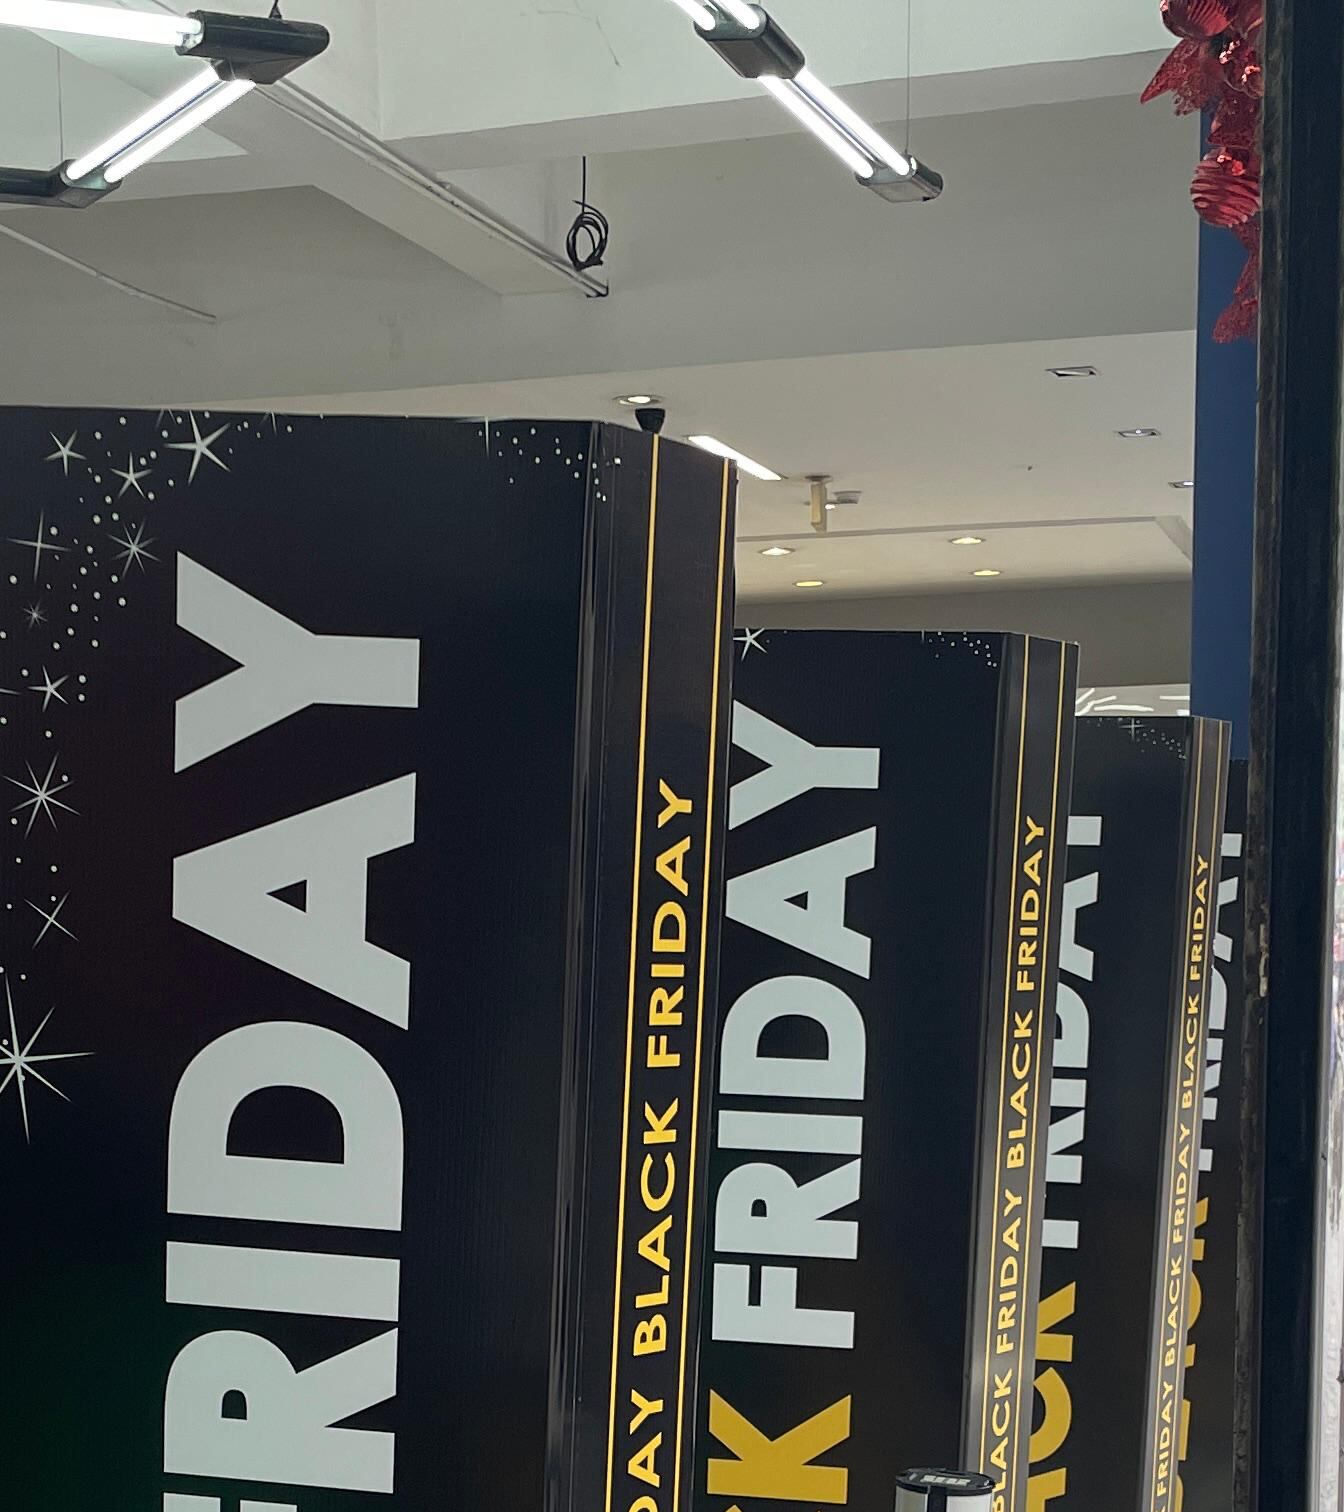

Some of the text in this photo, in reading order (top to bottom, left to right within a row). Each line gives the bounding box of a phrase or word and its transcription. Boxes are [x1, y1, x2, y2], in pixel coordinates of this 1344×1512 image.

[645, 777, 694, 1068] FRIDAY
[1014, 817, 1046, 992] FRIDAY
[1189, 854, 1210, 981] FRIDAY
[711, 699, 881, 1350] FRIDAY
[1006, 1008, 1035, 1169] BLACK
[1181, 993, 1201, 1110] BLACK
[632, 1098, 680, 1356] BLACK
[1172, 1122, 1192, 1244] FRIDAY
[996, 1188, 1023, 1355] FRIDAY
[1164, 1253, 1183, 1367] BLACK
[1156, 1380, 1175, 1496] FRIDAY
